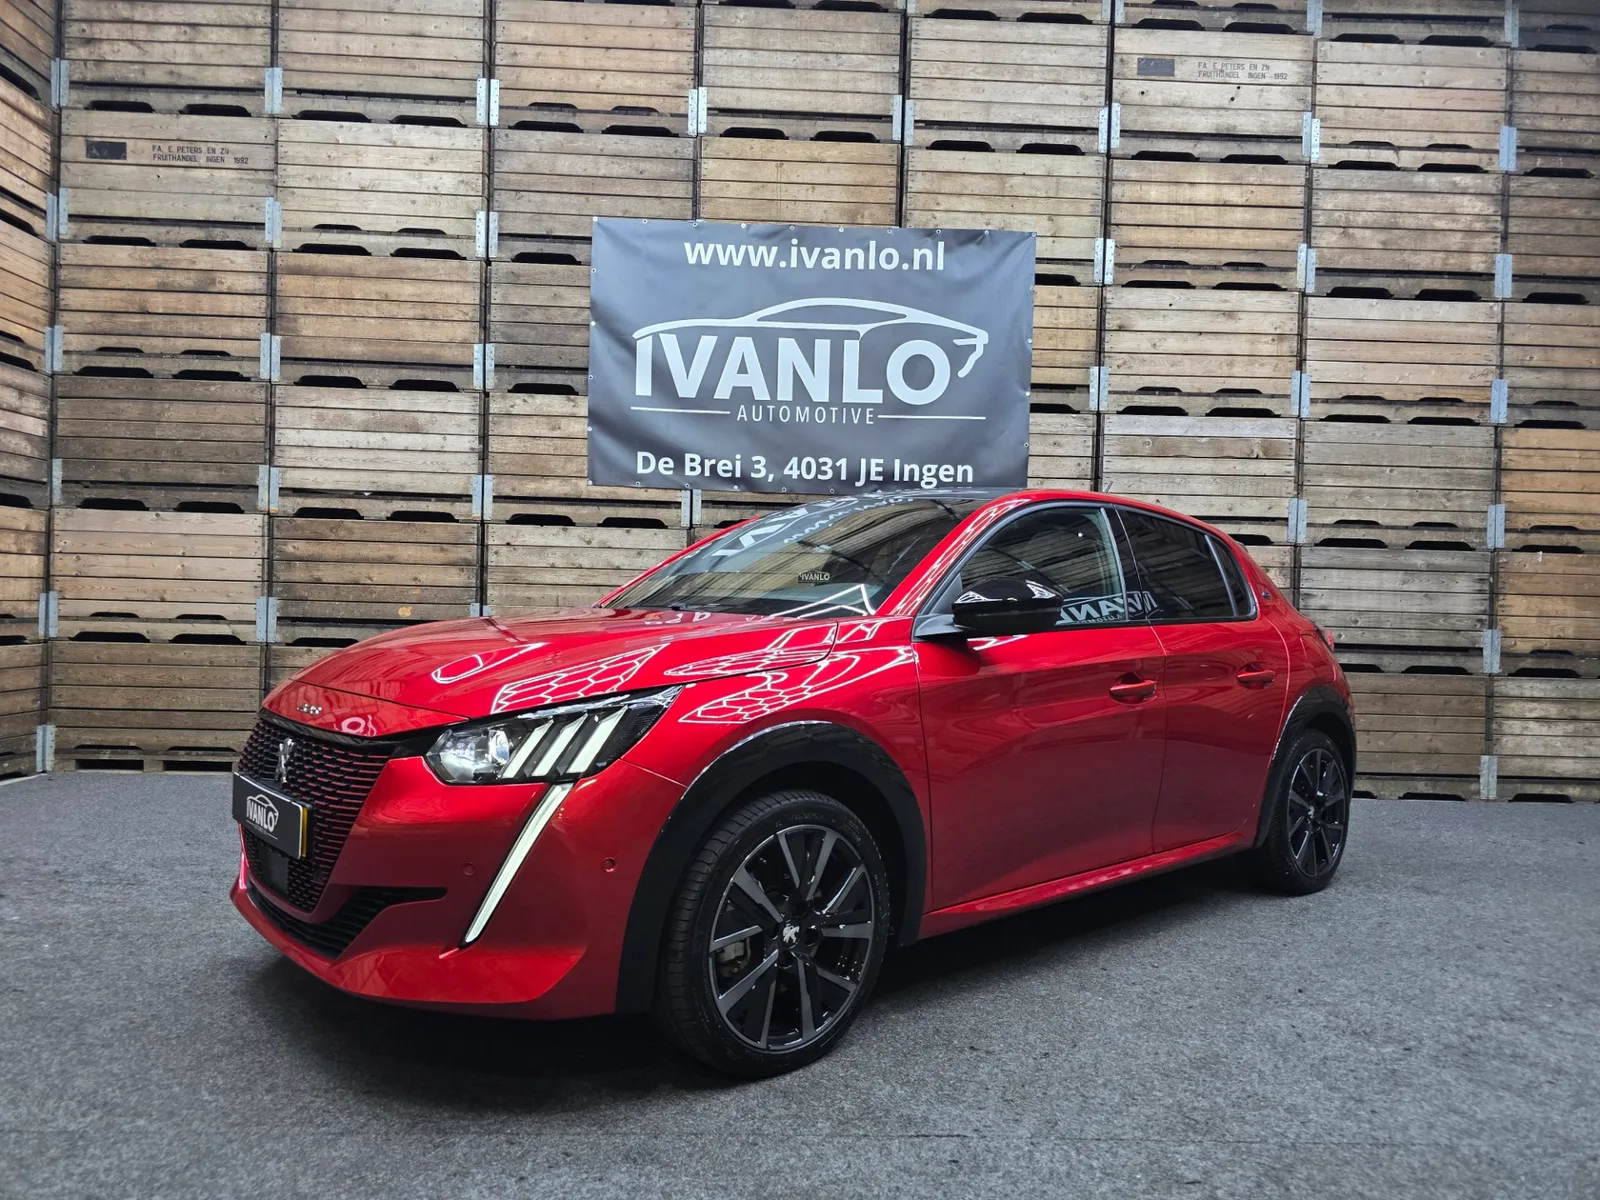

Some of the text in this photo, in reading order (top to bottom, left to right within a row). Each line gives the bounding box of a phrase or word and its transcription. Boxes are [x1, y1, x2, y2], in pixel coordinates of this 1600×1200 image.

[1221, 63, 1245, 71] PETERS
[1249, 63, 1258, 71] EN
[153, 153, 249, 165] FRUITHANDEL INGEN 1992
[177, 146, 203, 154] PETERS
[207, 147, 216, 155] EN
[684, 239, 945, 271] www.ivanlo.nl
[635, 333, 951, 405] IVANLO
[737, 405, 875, 425] AUTOMOTIVE
[636, 451, 974, 490] De Brei 3, 4031 JE Ingen
[800, 573, 831, 581] IVANLO
[246, 799, 275, 832] IVANLO
